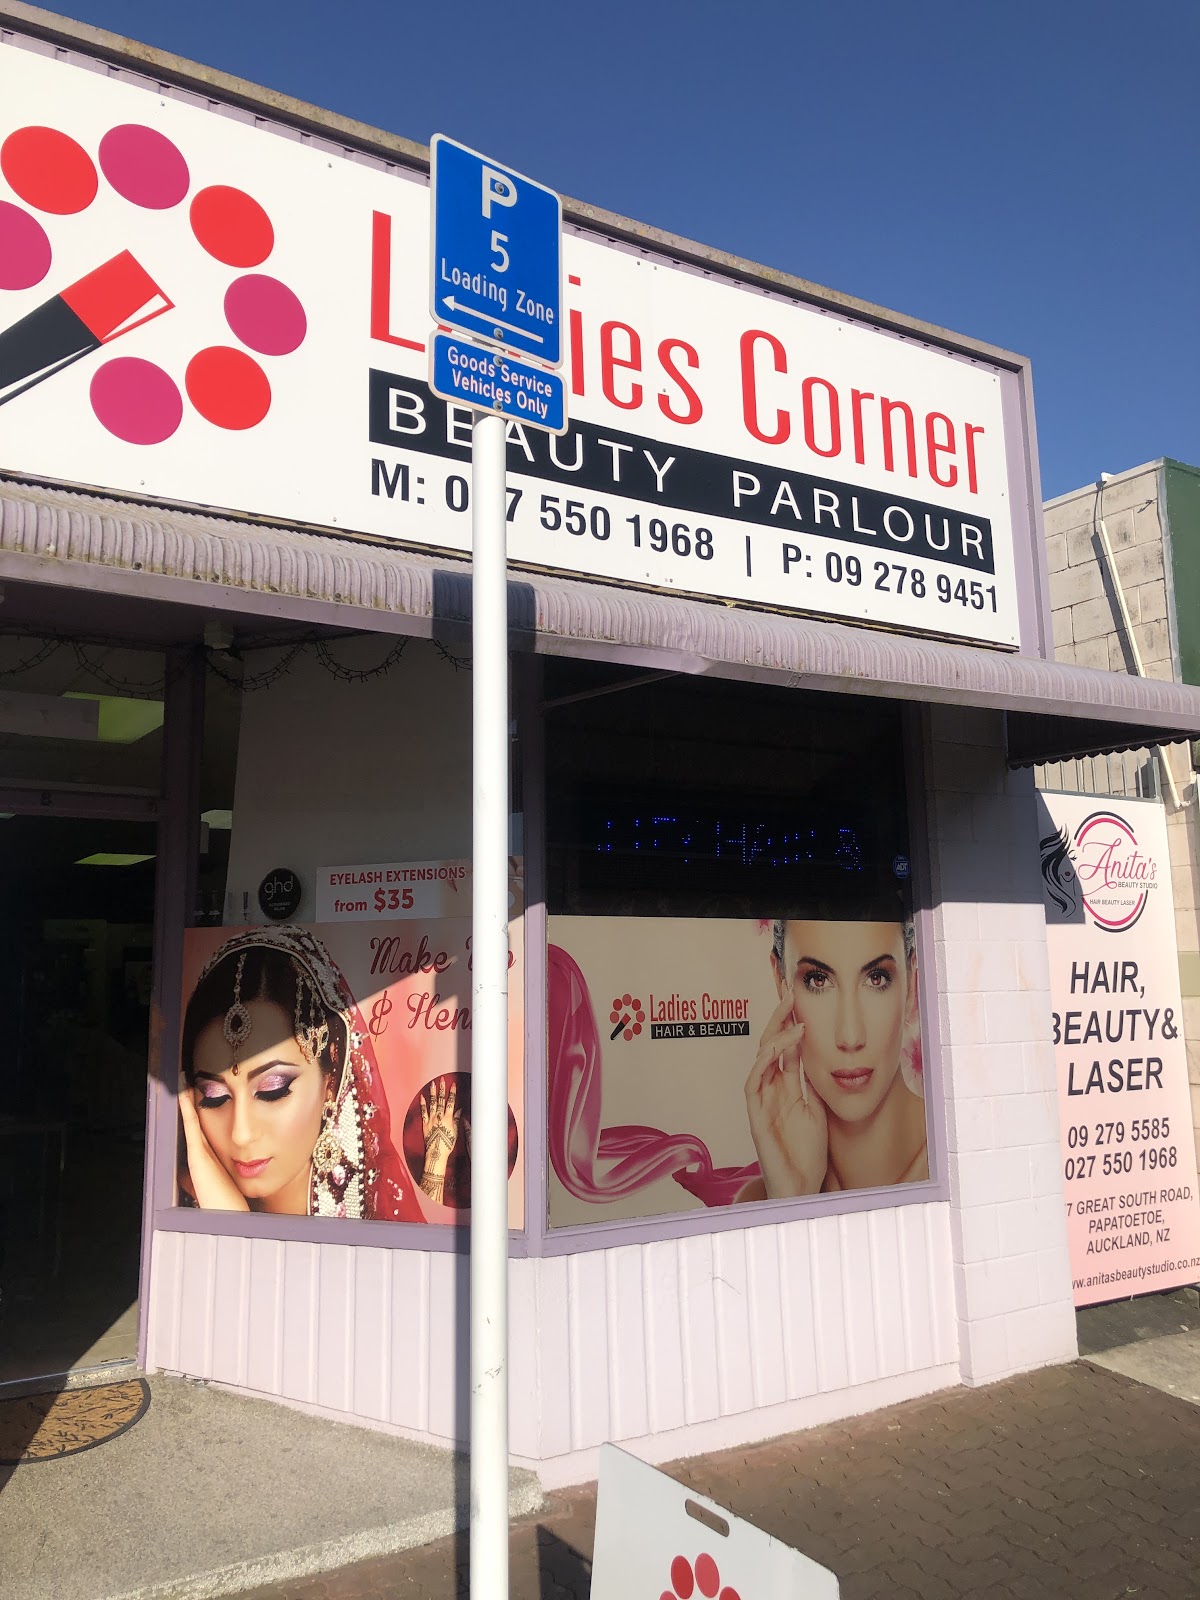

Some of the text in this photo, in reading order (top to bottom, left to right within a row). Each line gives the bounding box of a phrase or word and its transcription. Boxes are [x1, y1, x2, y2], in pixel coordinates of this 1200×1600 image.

[481, 164, 518, 219] P
[490, 230, 510, 273] 5
[441, 257, 555, 326] Loading Zone
[371, 209, 985, 495] Lies Corner
[447, 346, 553, 398] Goods Service
[452, 368, 549, 420] Vehicles Only
[388, 387, 985, 561] BEAUTY PARLOUR
[371, 457, 998, 614] M: 07 550 1968 P: 09 278 9451
[330, 866, 466, 887] EYELASH EXTENSIONS
[1078, 838, 1158, 890] Anita's
[264, 875, 294, 901] ghd
[334, 887, 415, 913] from $35
[1089, 898, 1102, 906] HAIR
[1117, 881, 1139, 889] BEAUTY
[370, 935, 455, 975] Make
[1070, 961, 1145, 999] HAIR,
[368, 989, 393, 1042] &
[650, 992, 749, 1021] Ladies Corner
[655, 1022, 746, 1038] HAIR & BEAUTY
[1067, 1057, 1164, 1096] LASER
[1068, 1117, 1170, 1148] 09 279 5585
[1064, 1146, 1178, 1180] 027 550 1968
[1076, 1196, 1116, 1215] GREAT
[1119, 1190, 1157, 1209] SOUTH
[1160, 1186, 1193, 1203] ROAD,
[1088, 1210, 1165, 1234] PAPATOETOE,
[1086, 1228, 1171, 1255] AUCKLAND, NZ
